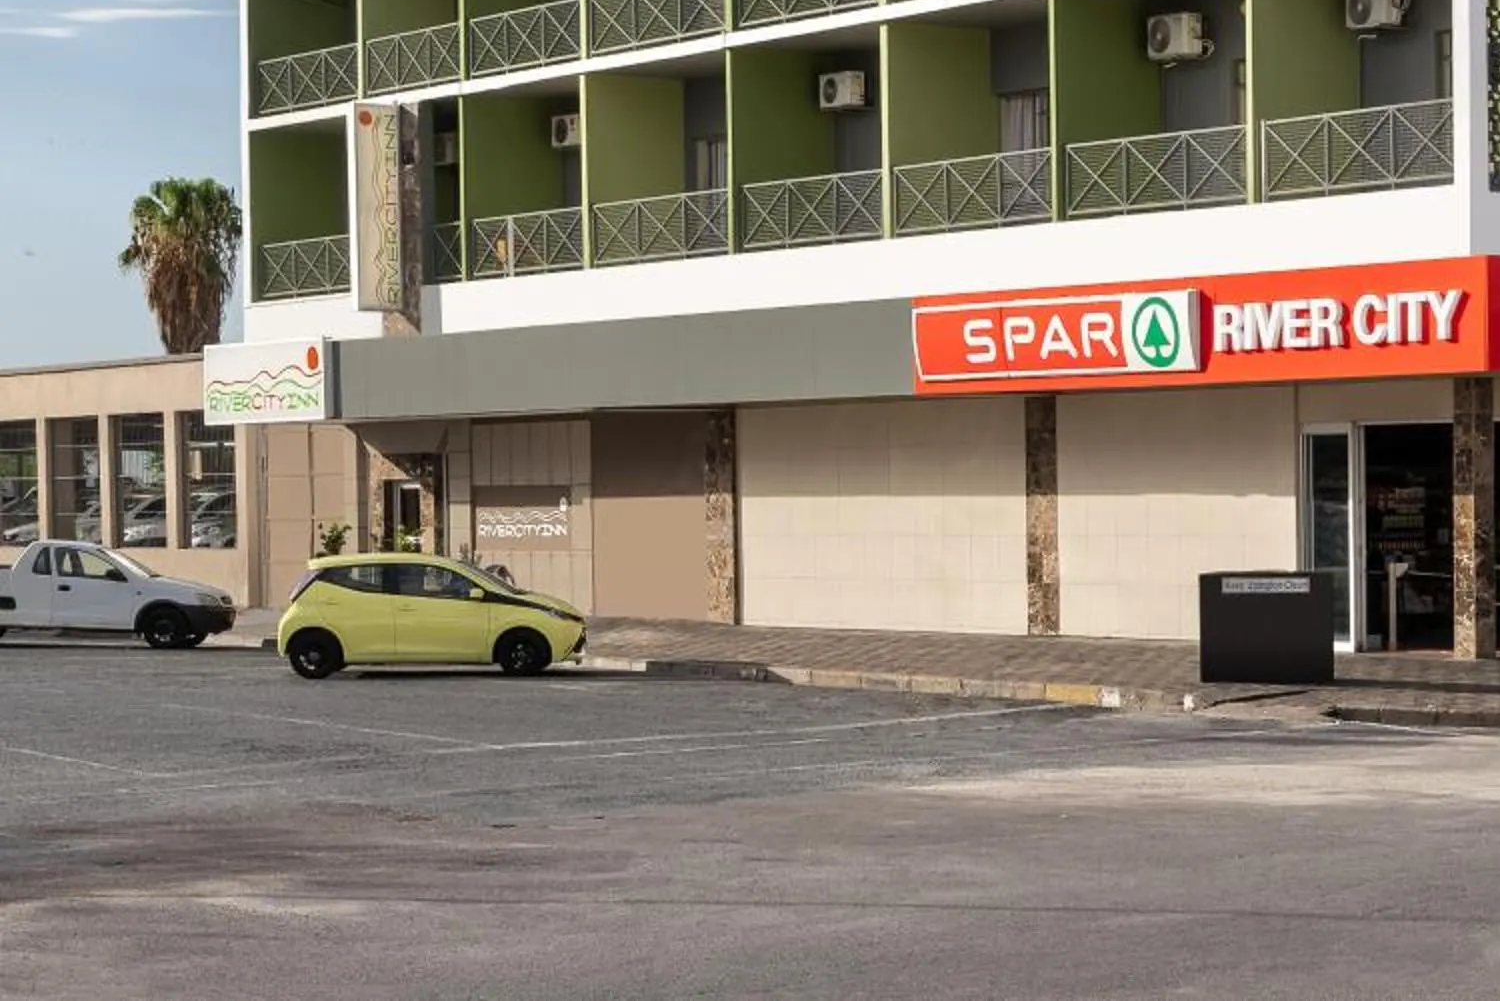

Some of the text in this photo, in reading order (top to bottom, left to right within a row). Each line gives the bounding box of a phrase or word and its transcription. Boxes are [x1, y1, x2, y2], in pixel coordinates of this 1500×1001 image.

[962, 288, 1465, 364] SPAR RIVER CITY
